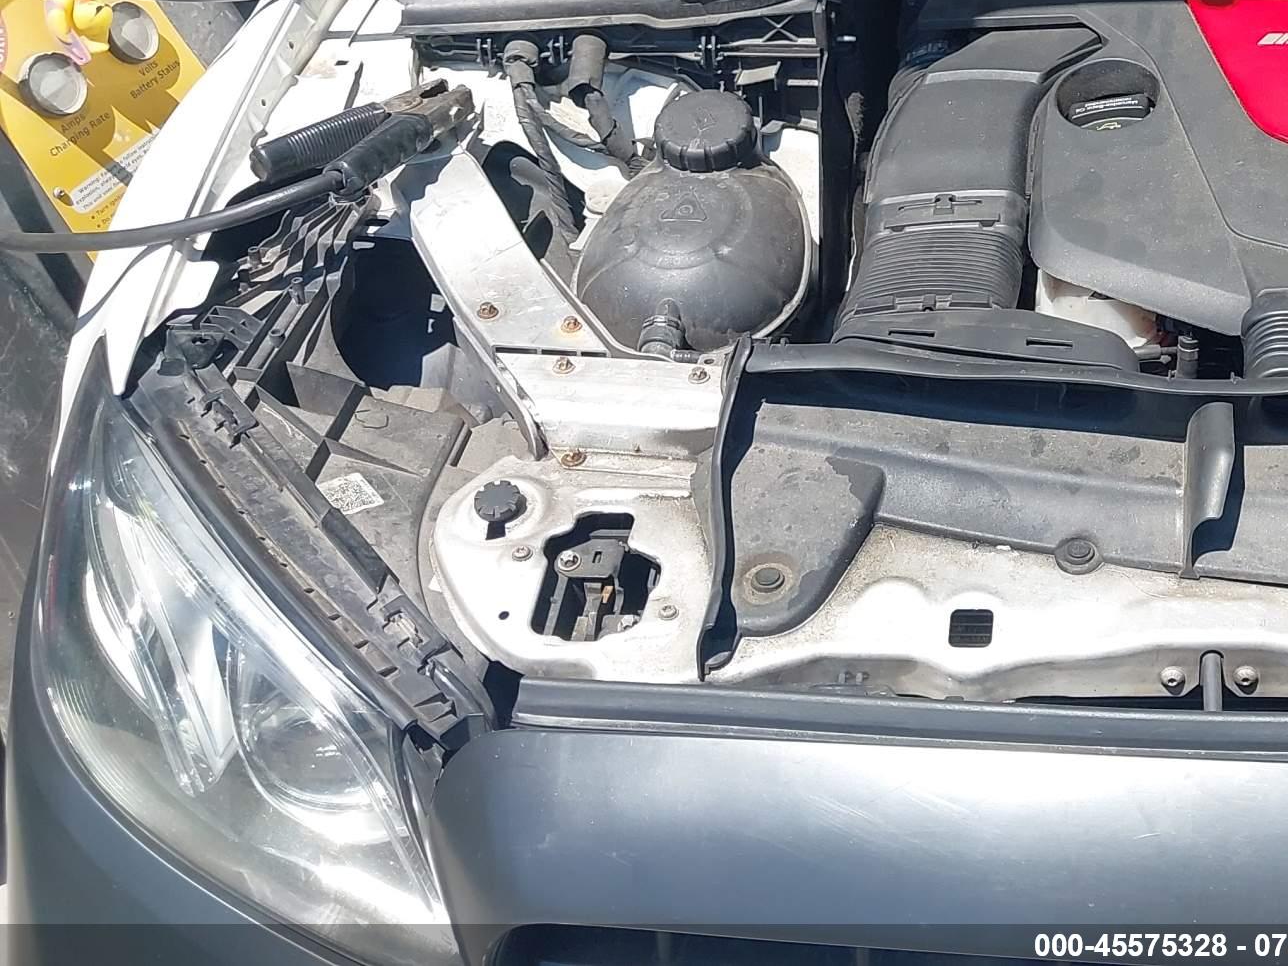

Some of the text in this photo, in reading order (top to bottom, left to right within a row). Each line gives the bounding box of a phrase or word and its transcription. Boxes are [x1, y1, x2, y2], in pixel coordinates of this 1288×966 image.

[130, 60, 180, 99] Battery Status
[139, 60, 158, 76] Volts
[49, 112, 110, 157] Charging Rate
[61, 113, 86, 133] Amps
